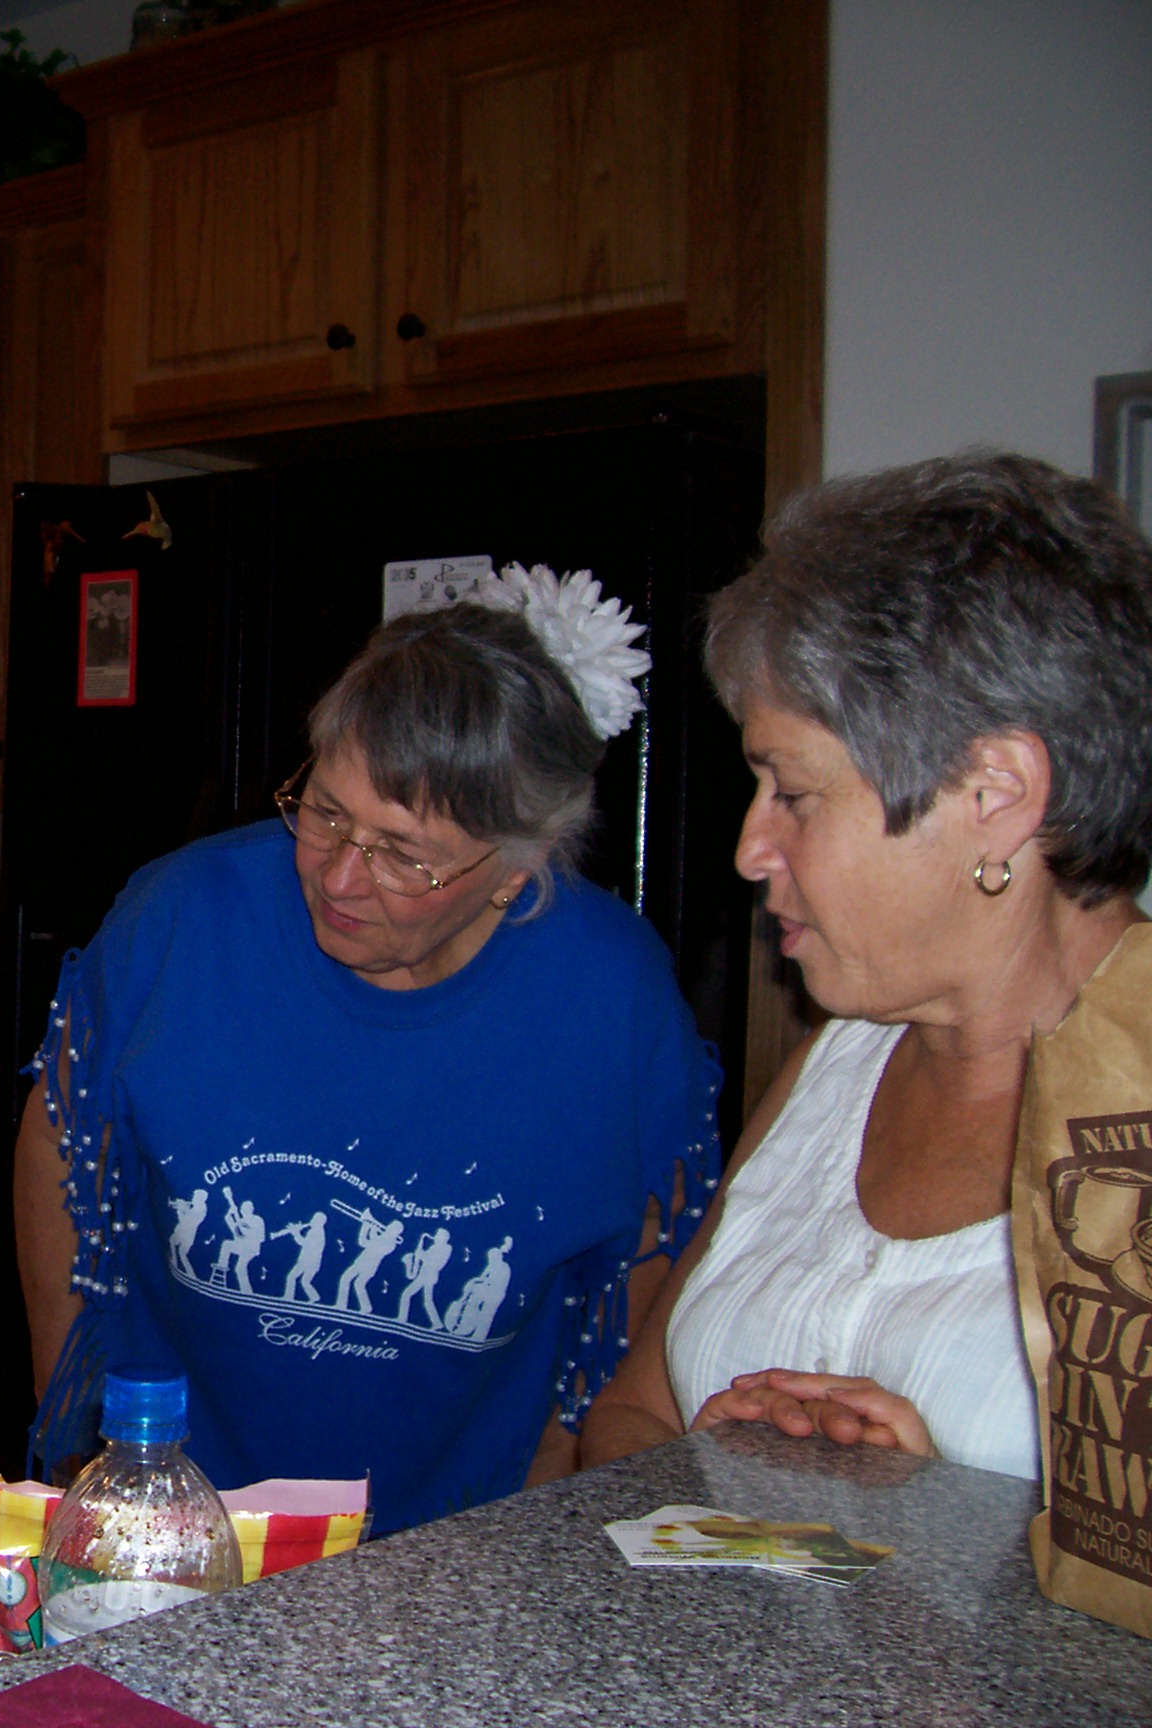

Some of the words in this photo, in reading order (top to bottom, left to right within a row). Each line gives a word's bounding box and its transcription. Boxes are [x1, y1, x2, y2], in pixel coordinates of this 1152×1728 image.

[204, 1162, 230, 1185] Old
[367, 1184, 386, 1201] of
[381, 1193, 405, 1212] the
[403, 1201, 439, 1218] Jazz
[440, 1192, 505, 1221] Festival
[257, 1313, 400, 1361] California
